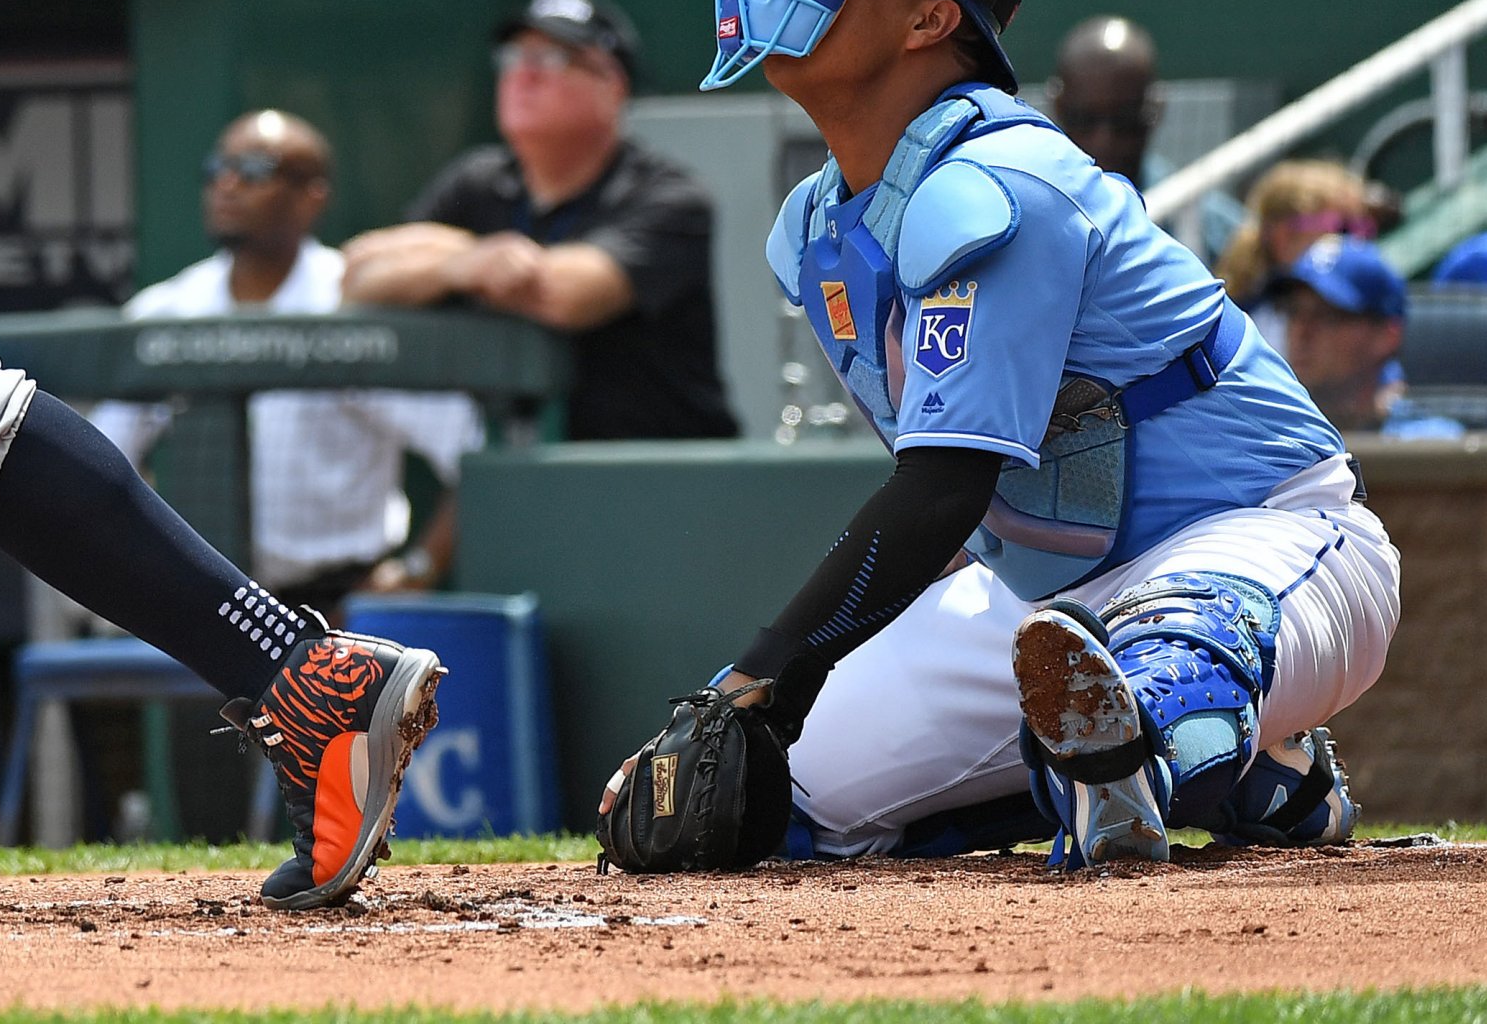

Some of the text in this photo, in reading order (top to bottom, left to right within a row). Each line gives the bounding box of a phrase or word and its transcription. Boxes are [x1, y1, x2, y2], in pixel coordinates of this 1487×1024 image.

[919, 314, 964, 360] KC
[404, 726, 483, 829] C
[655, 760, 670, 813] Rawlings
